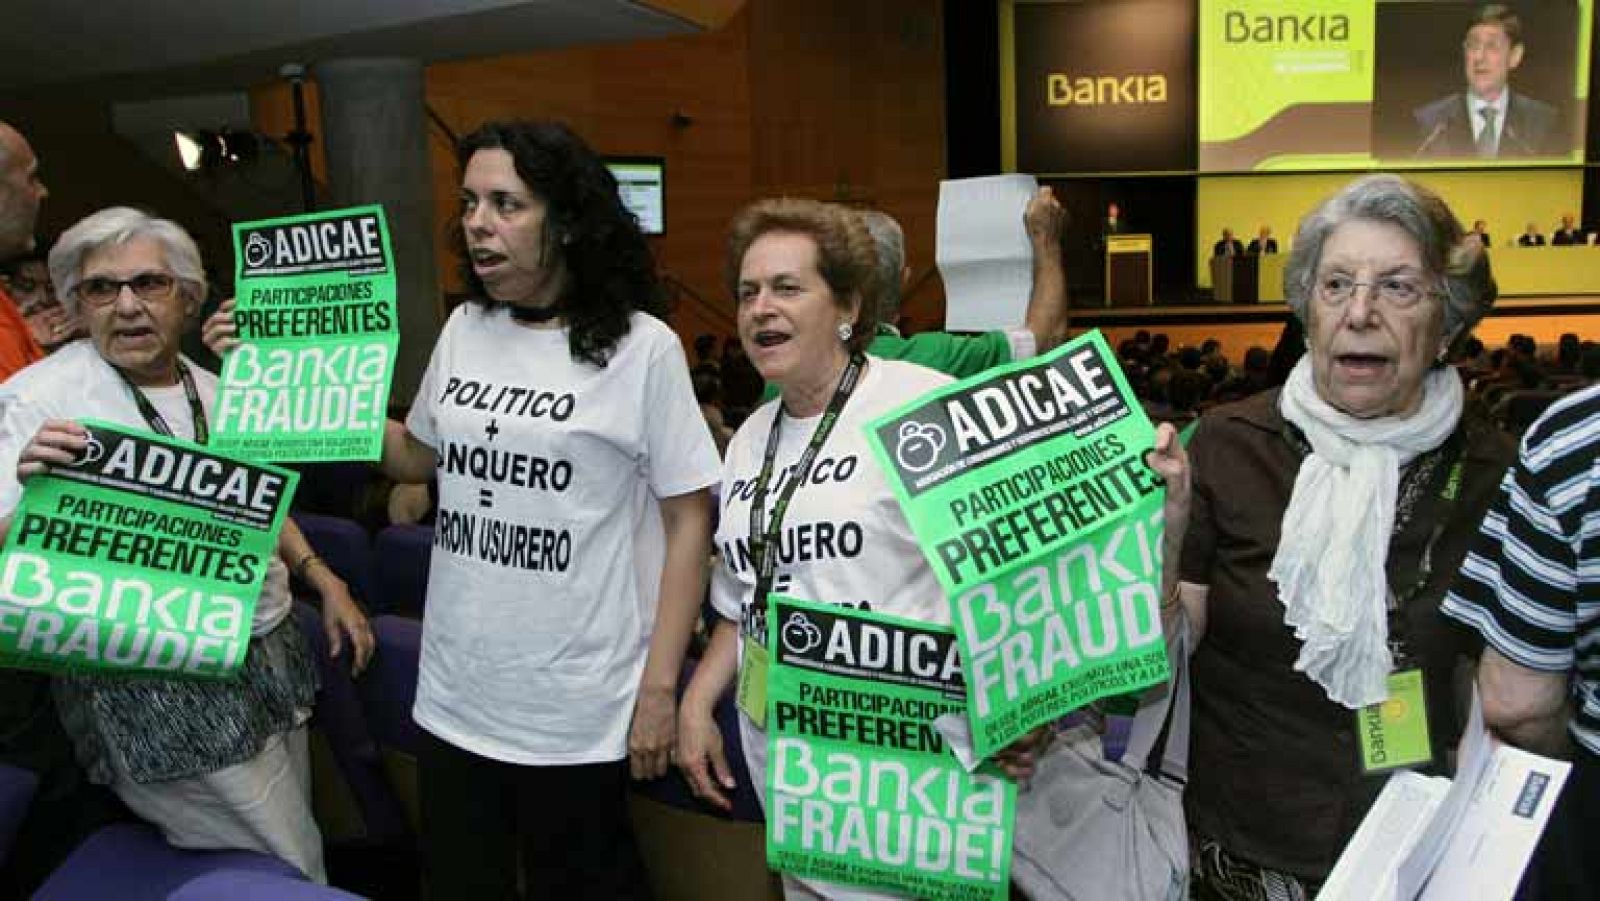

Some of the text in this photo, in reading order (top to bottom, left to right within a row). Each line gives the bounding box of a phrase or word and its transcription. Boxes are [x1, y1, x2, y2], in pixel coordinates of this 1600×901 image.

[1225, 11, 1349, 42] Bankia
[1048, 74, 1167, 105] Bankia
[275, 216, 381, 266] ADICAE
[234, 302, 391, 338] PREFERENTES
[251, 281, 372, 306] PARTICIPACIONES
[228, 343, 387, 387] Bankia
[215, 381, 383, 434] FRAUDE!
[440, 377, 575, 421] POLITICO
[946, 349, 1113, 452] ADICAE
[102, 438, 282, 511] ADICAE
[726, 454, 858, 509] POICO
[949, 432, 1126, 527] PARTICIPACIONES
[57, 494, 243, 548] PARTICIPACIONES
[435, 508, 572, 572] RON USURERO
[724, 521, 864, 574] NUERO
[17, 513, 260, 585] PREFERENTES
[1, 552, 244, 638] Bankia
[799, 681, 967, 722] PARTICIPACIO
[775, 737, 1002, 824] Bankia
[773, 797, 1005, 881] FRAUDE!
